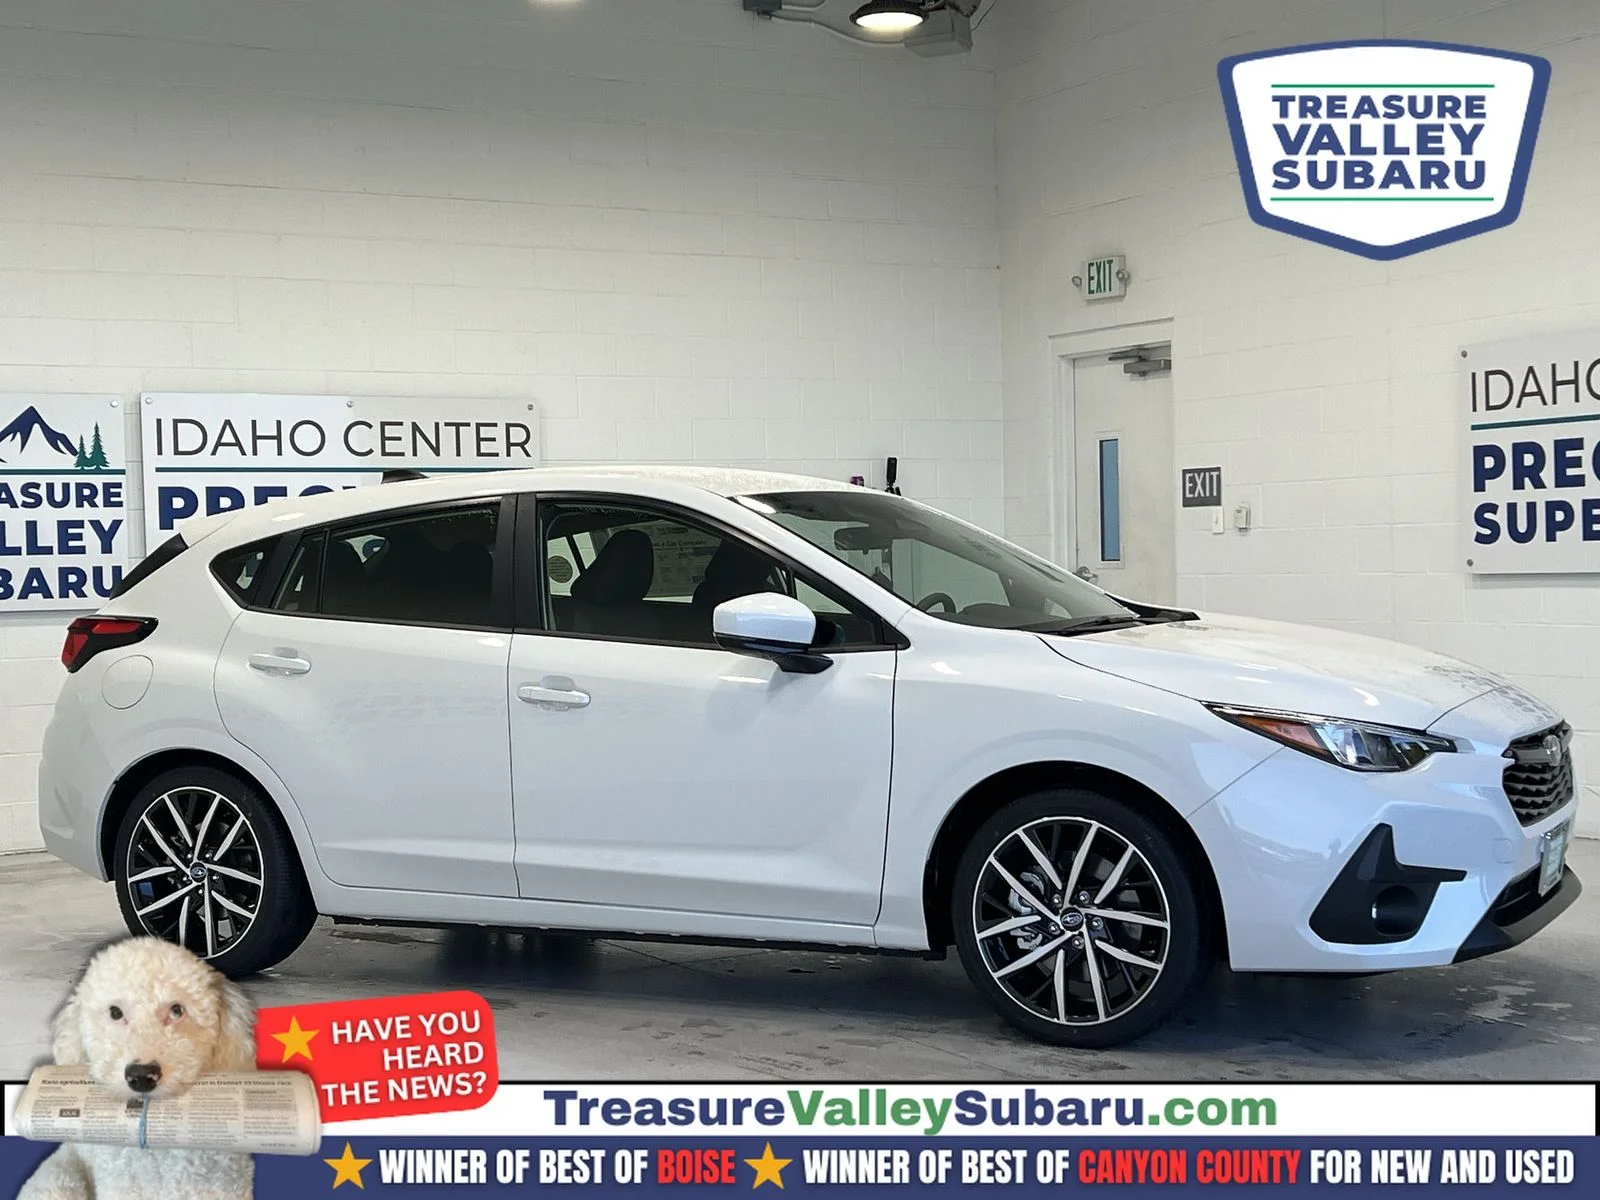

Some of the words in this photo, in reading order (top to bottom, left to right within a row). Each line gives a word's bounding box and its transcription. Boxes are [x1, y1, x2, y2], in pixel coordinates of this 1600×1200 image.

[1087, 259, 1114, 294] EXIT
[155, 417, 326, 458] IDAHO
[343, 418, 532, 458] CENTER
[1473, 437, 1600, 492] PRE
[1185, 471, 1220, 498] EXIT
[0, 519, 124, 556] LLEY
